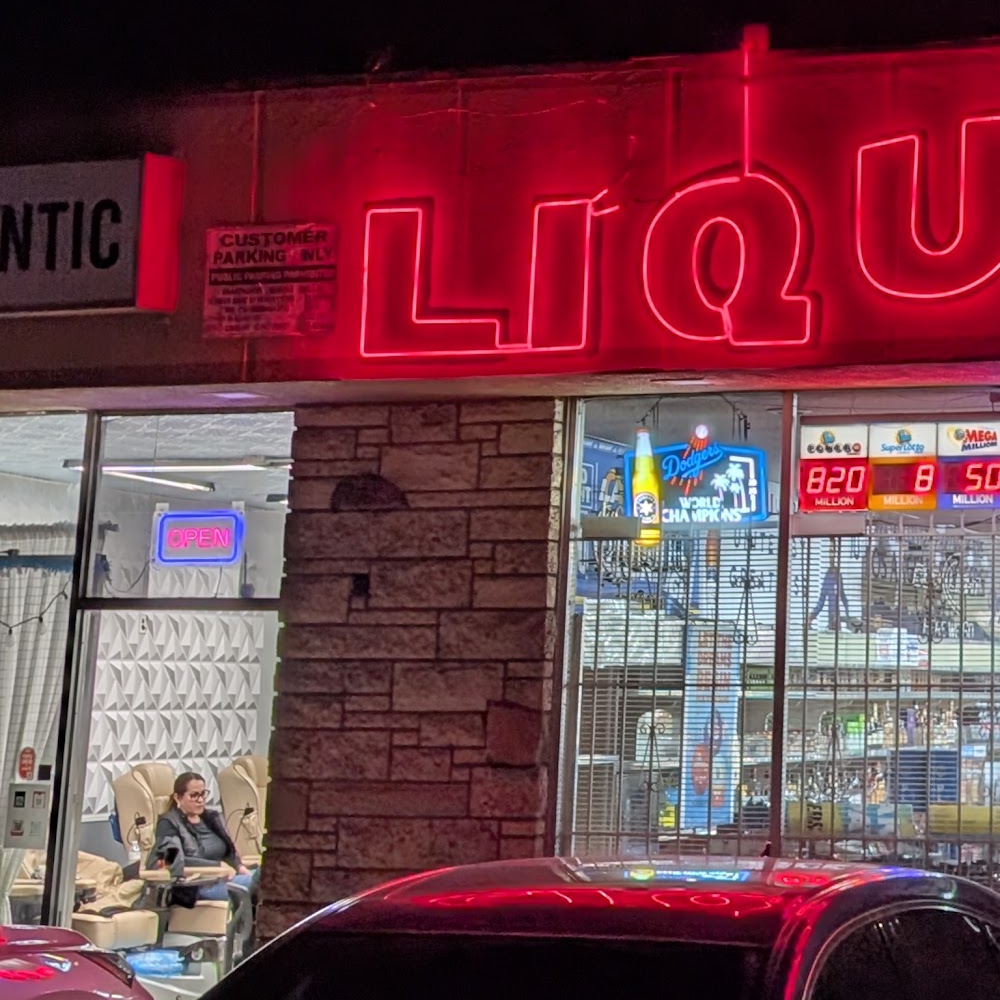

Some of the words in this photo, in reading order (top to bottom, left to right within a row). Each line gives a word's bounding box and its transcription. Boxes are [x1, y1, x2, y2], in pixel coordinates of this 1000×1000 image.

[220, 230, 328, 247] CUSTOMER
[213, 250, 287, 264] PARKING
[965, 428, 998, 441] MEGA
[880, 443, 925, 454] SuperLotto
[661, 442, 723, 480] Dodgers
[806, 466, 865, 494] 820
[914, 465, 935, 492] 8
[678, 496, 722, 509] WORLD
[815, 497, 854, 506] MILLION
[883, 495, 923, 505] MILLION
[952, 494, 993, 504] MILLION
[661, 507, 742, 523] CHAMPIONS
[167, 527, 231, 549] OPEN
